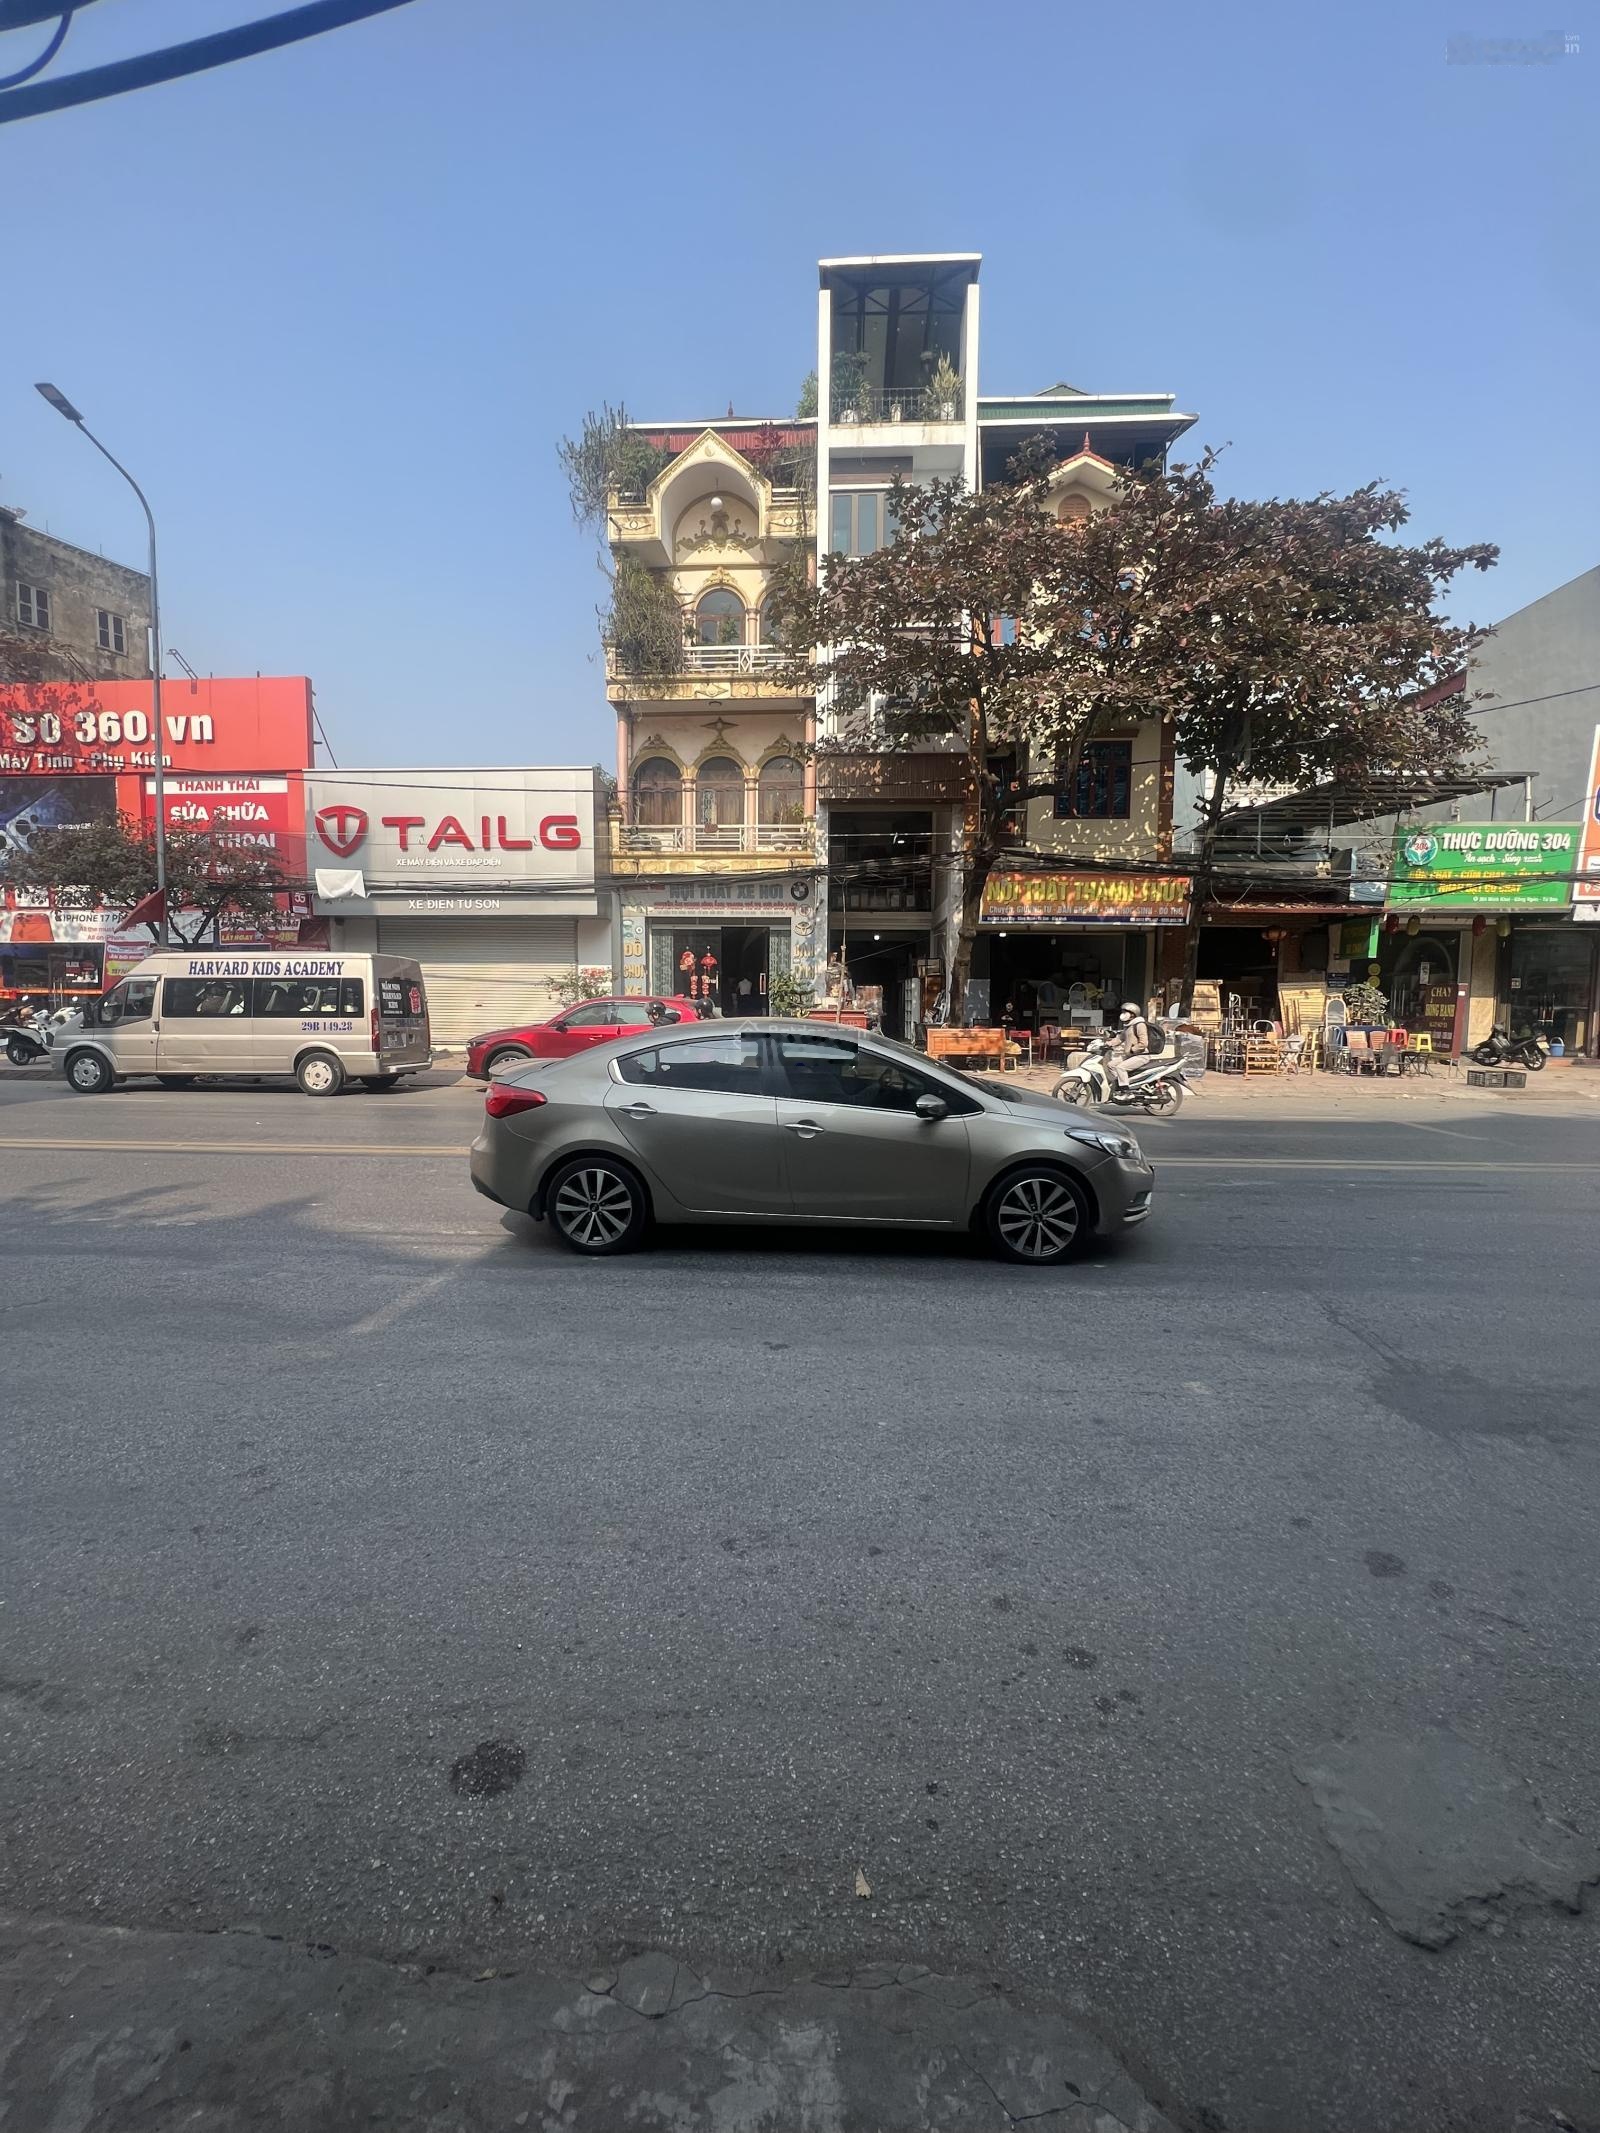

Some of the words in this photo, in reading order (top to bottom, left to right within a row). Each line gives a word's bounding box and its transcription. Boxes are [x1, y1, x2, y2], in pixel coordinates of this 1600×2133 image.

[177, 780, 224, 791] THANH
[227, 777, 260, 791] THÁI
[170, 800, 209, 821] SỬA
[213, 802, 269, 821] CHỮA
[382, 815, 582, 852] TAILG
[1443, 831, 1482, 854] THỰC
[1485, 829, 1539, 850] DƯỠNG
[1542, 833, 1571, 850] 304
[737, 884, 755, 899] XE
[409, 899, 423, 909] XE
[63, 914, 98, 922] IPHONE
[101, 914, 109, 922] 17
[188, 961, 248, 976] HARVARD
[252, 961, 281, 976] KIDS
[284, 961, 344, 976] ACADEMY
[301, 1021, 319, 1031] 29B
